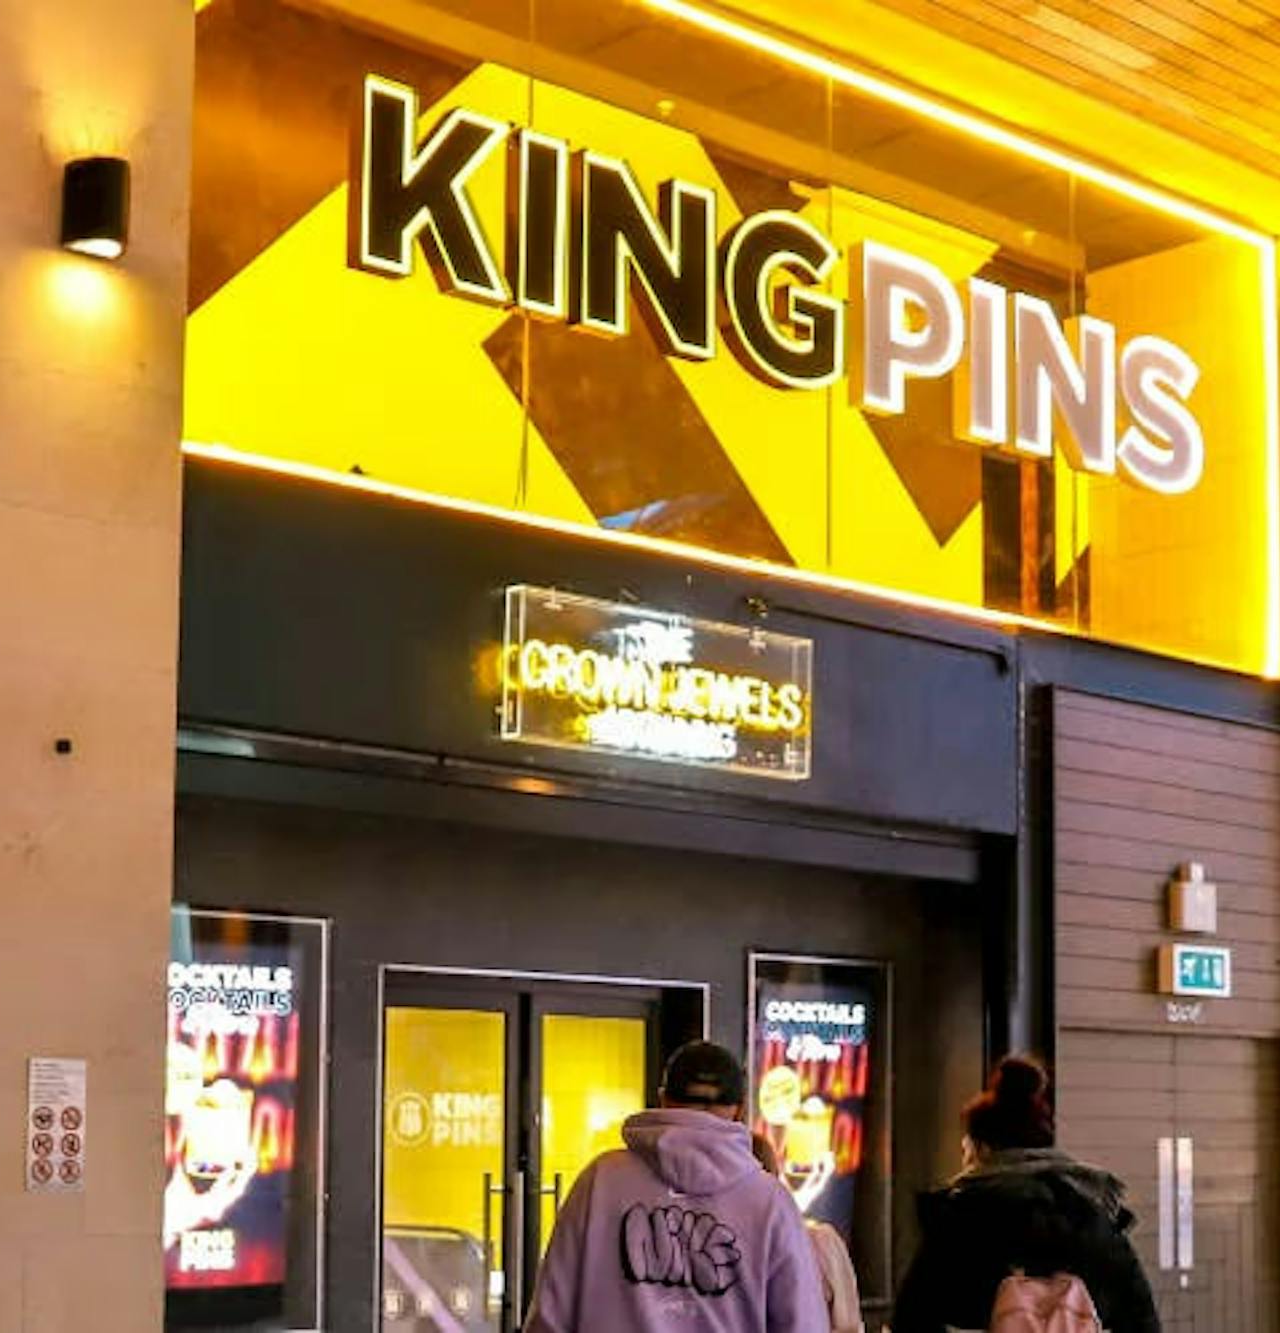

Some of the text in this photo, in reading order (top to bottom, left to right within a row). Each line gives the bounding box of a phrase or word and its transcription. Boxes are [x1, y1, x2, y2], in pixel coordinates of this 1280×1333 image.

[522, 639, 802, 730] CROWN JEWELS
[168, 962, 293, 990] OCKTAILS
[168, 986, 293, 1018] OCKTAILS
[432, 1092, 501, 1119] KING
[432, 1120, 501, 1146] PINS
